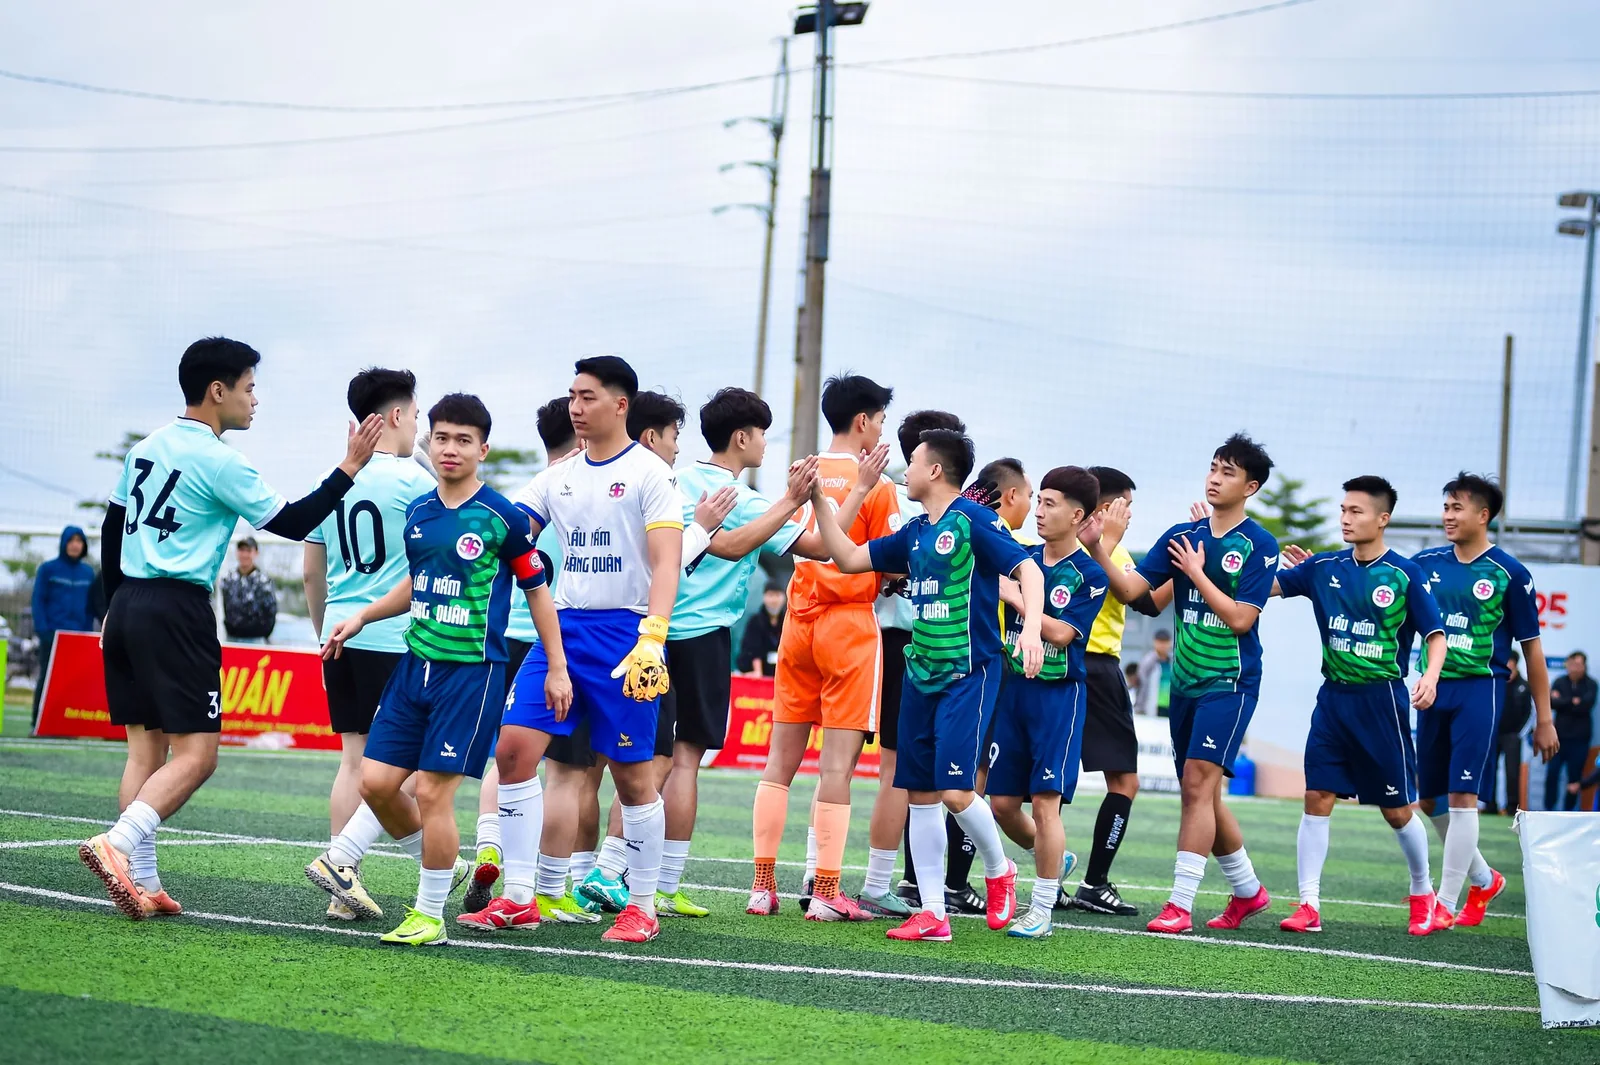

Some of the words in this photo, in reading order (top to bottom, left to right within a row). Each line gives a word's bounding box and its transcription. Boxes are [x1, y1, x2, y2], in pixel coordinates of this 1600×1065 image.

[820, 475, 849, 491] iversity
[125, 457, 184, 544] 34
[334, 498, 387, 575] 10
[592, 553, 622, 574] QUÂN
[432, 574, 461, 597] NẤM
[435, 604, 471, 626] QUÂN
[923, 600, 950, 621] QUÂN
[1351, 618, 1376, 637] NẤM
[1354, 640, 1384, 659] QUÂN
[219, 654, 294, 717] UÁN
[207, 691, 222, 719] 3
